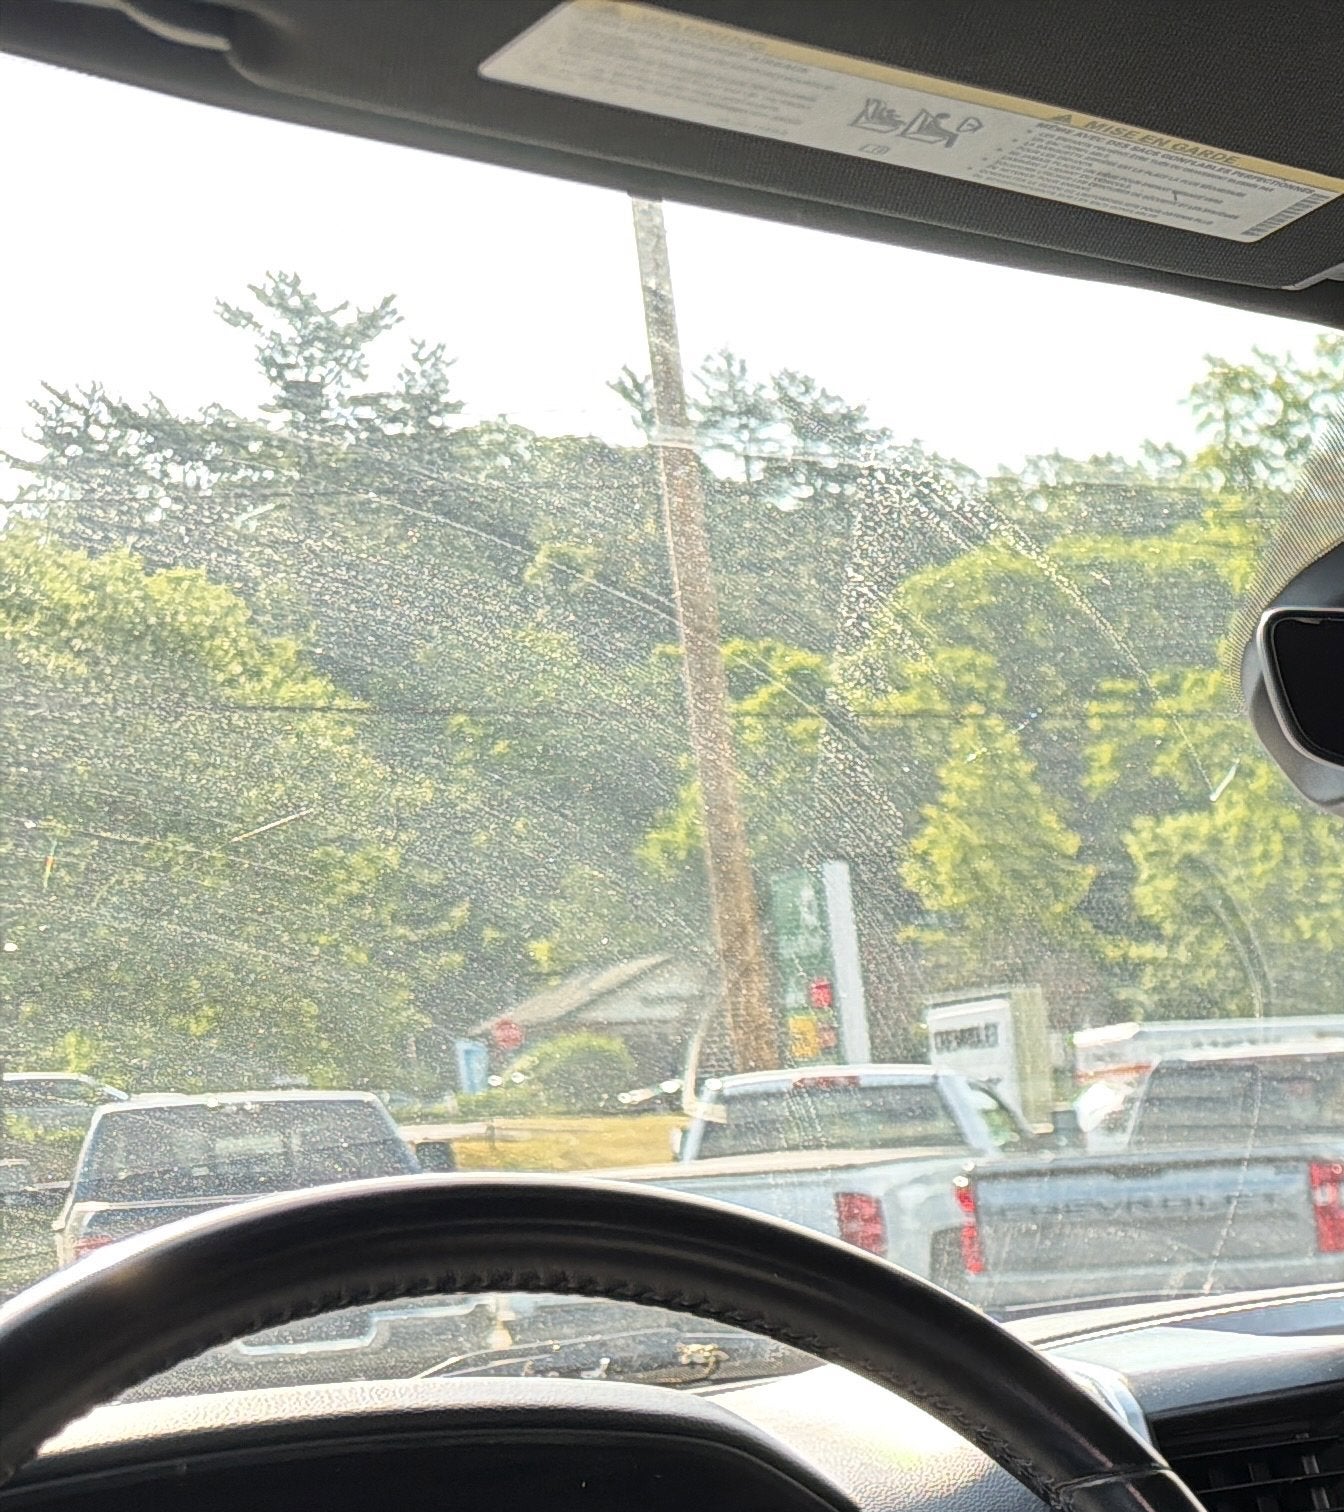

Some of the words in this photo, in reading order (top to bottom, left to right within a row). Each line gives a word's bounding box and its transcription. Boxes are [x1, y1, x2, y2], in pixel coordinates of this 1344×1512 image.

[1083, 119, 1138, 139] MISE
[1139, 133, 1172, 147] EN
[1171, 141, 1241, 165] GARDE
